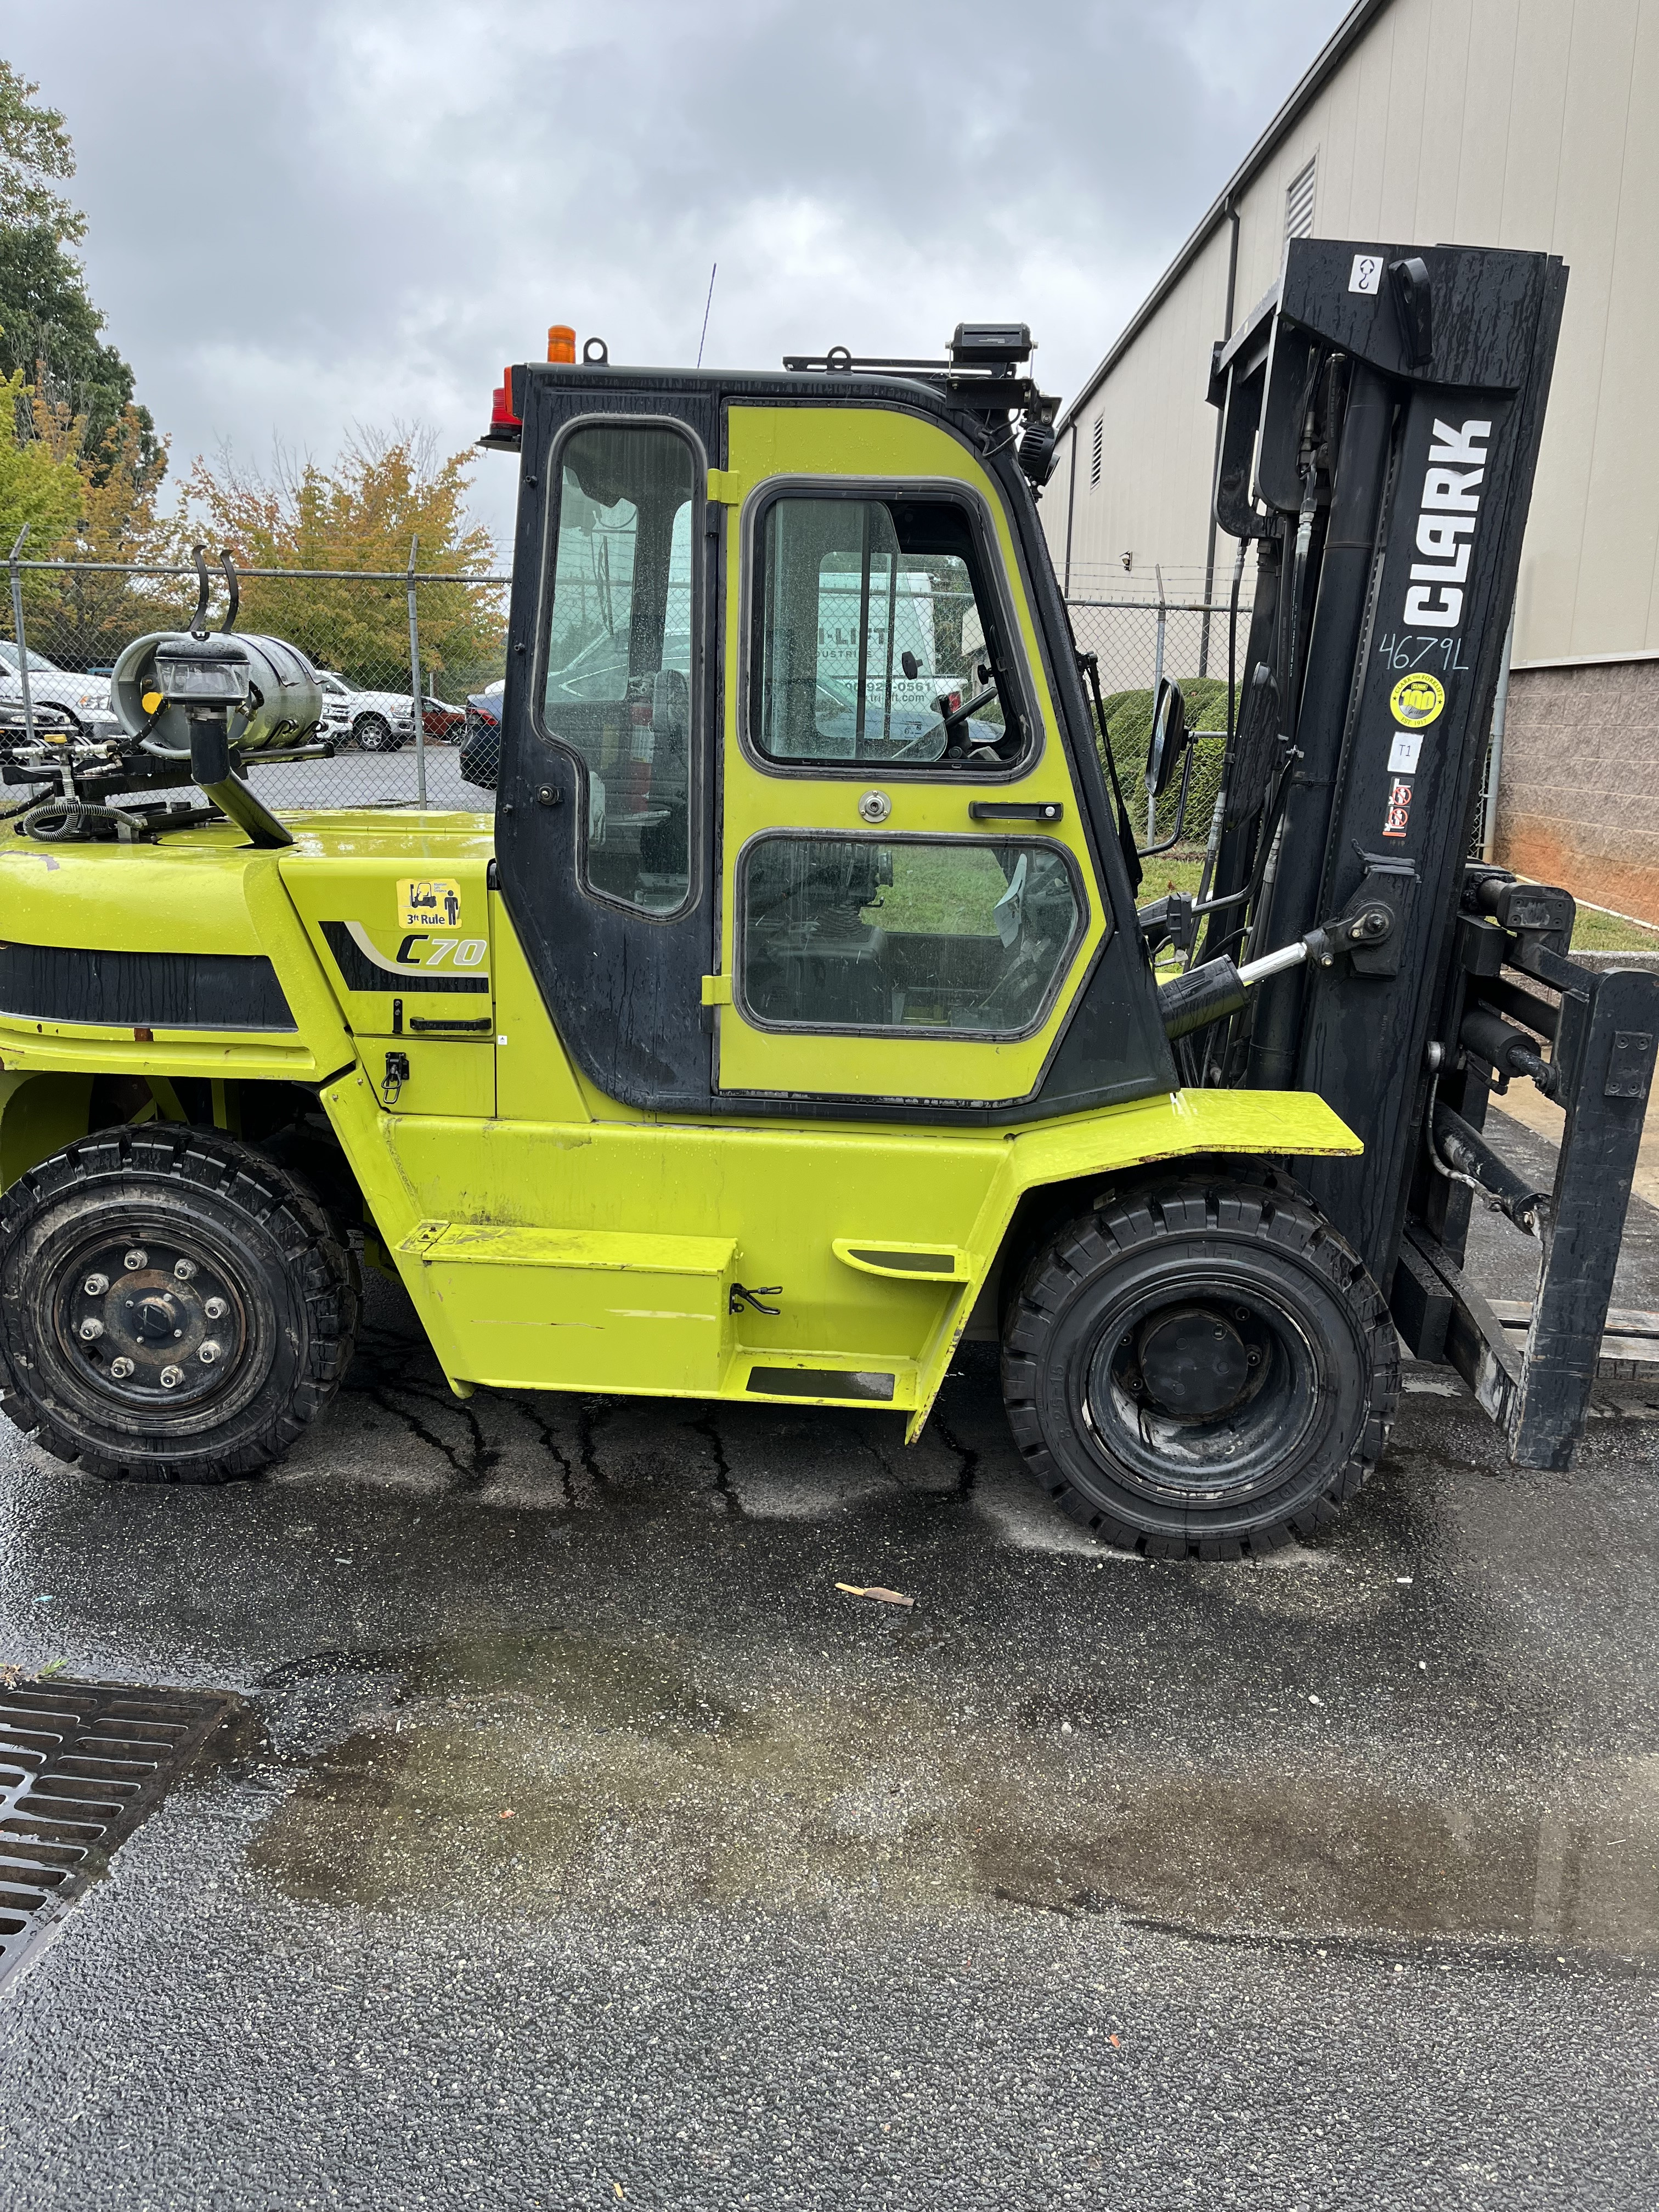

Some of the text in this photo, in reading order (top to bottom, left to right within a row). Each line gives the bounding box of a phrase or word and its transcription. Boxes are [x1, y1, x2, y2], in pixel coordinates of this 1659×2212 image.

[1403, 418, 1492, 627] CLARK
[819, 628, 889, 645] I-LIT
[1379, 633, 1469, 670] 4679L
[1395, 677, 1412, 693] CLARK
[1421, 675, 1443, 697] FORKLIFT
[1401, 689, 1435, 710] 100
[1399, 744, 1410, 757] T1
[421, 914, 445, 924] Rule
[396, 934, 487, 966] C70
[1187, 1242, 1327, 1307] MAGNUM
[1049, 1364, 1073, 1440] 8.25-15
